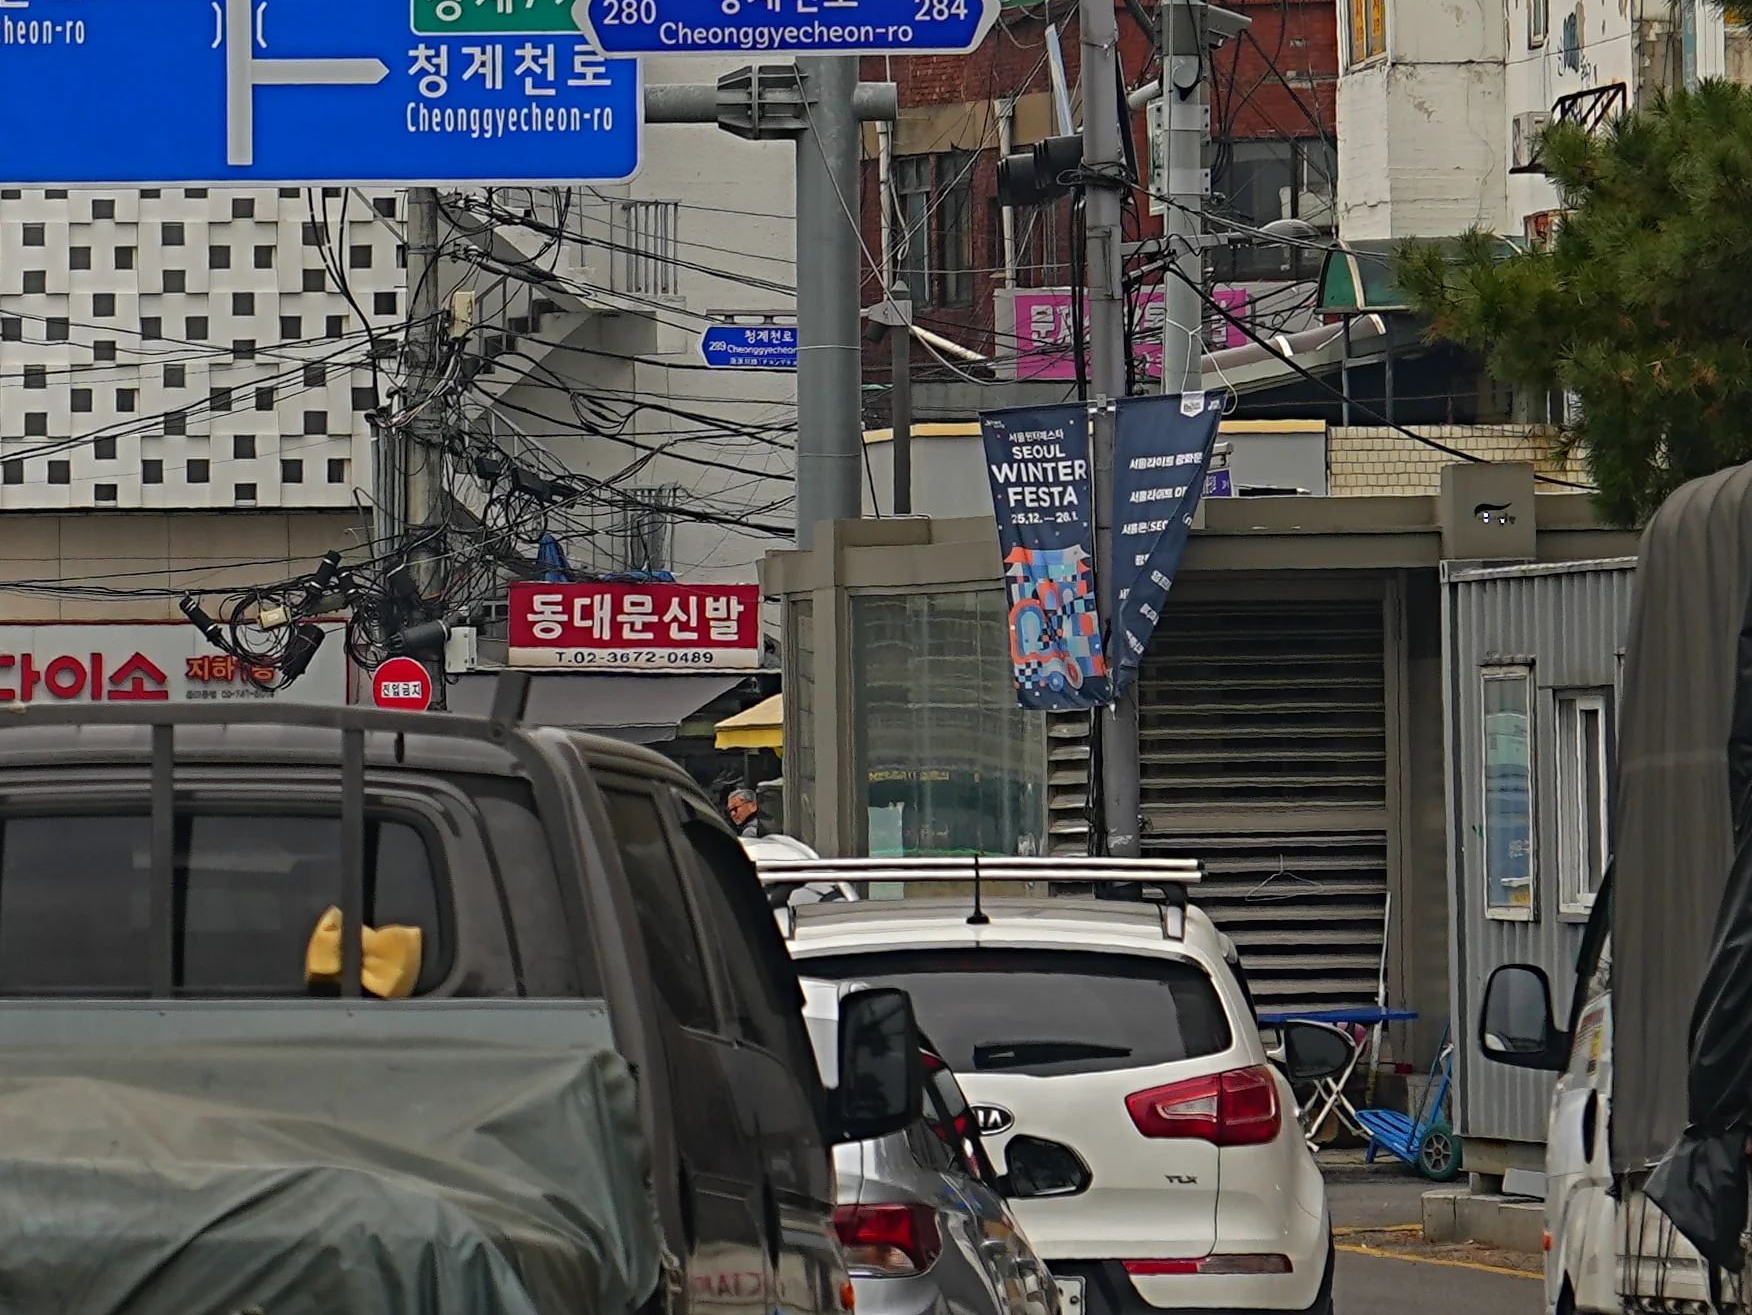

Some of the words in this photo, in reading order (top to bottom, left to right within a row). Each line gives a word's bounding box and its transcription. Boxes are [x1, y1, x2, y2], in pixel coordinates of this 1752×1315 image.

[660, 20, 913, 48] Cheonggyecheon-ro
[407, 43, 613, 98] 청계천로
[406, 101, 614, 139] Cheonggyecheon-ro
[745, 329, 794, 344] 청계천로
[1011, 444, 1066, 460] SEOUL
[991, 459, 1087, 484] WINTER
[1007, 486, 1079, 508] FESTA
[526, 591, 745, 642] 동대문신발
[556, 650, 715, 665] T.02-3672-0489
[380, 681, 423, 698] 진입금지
